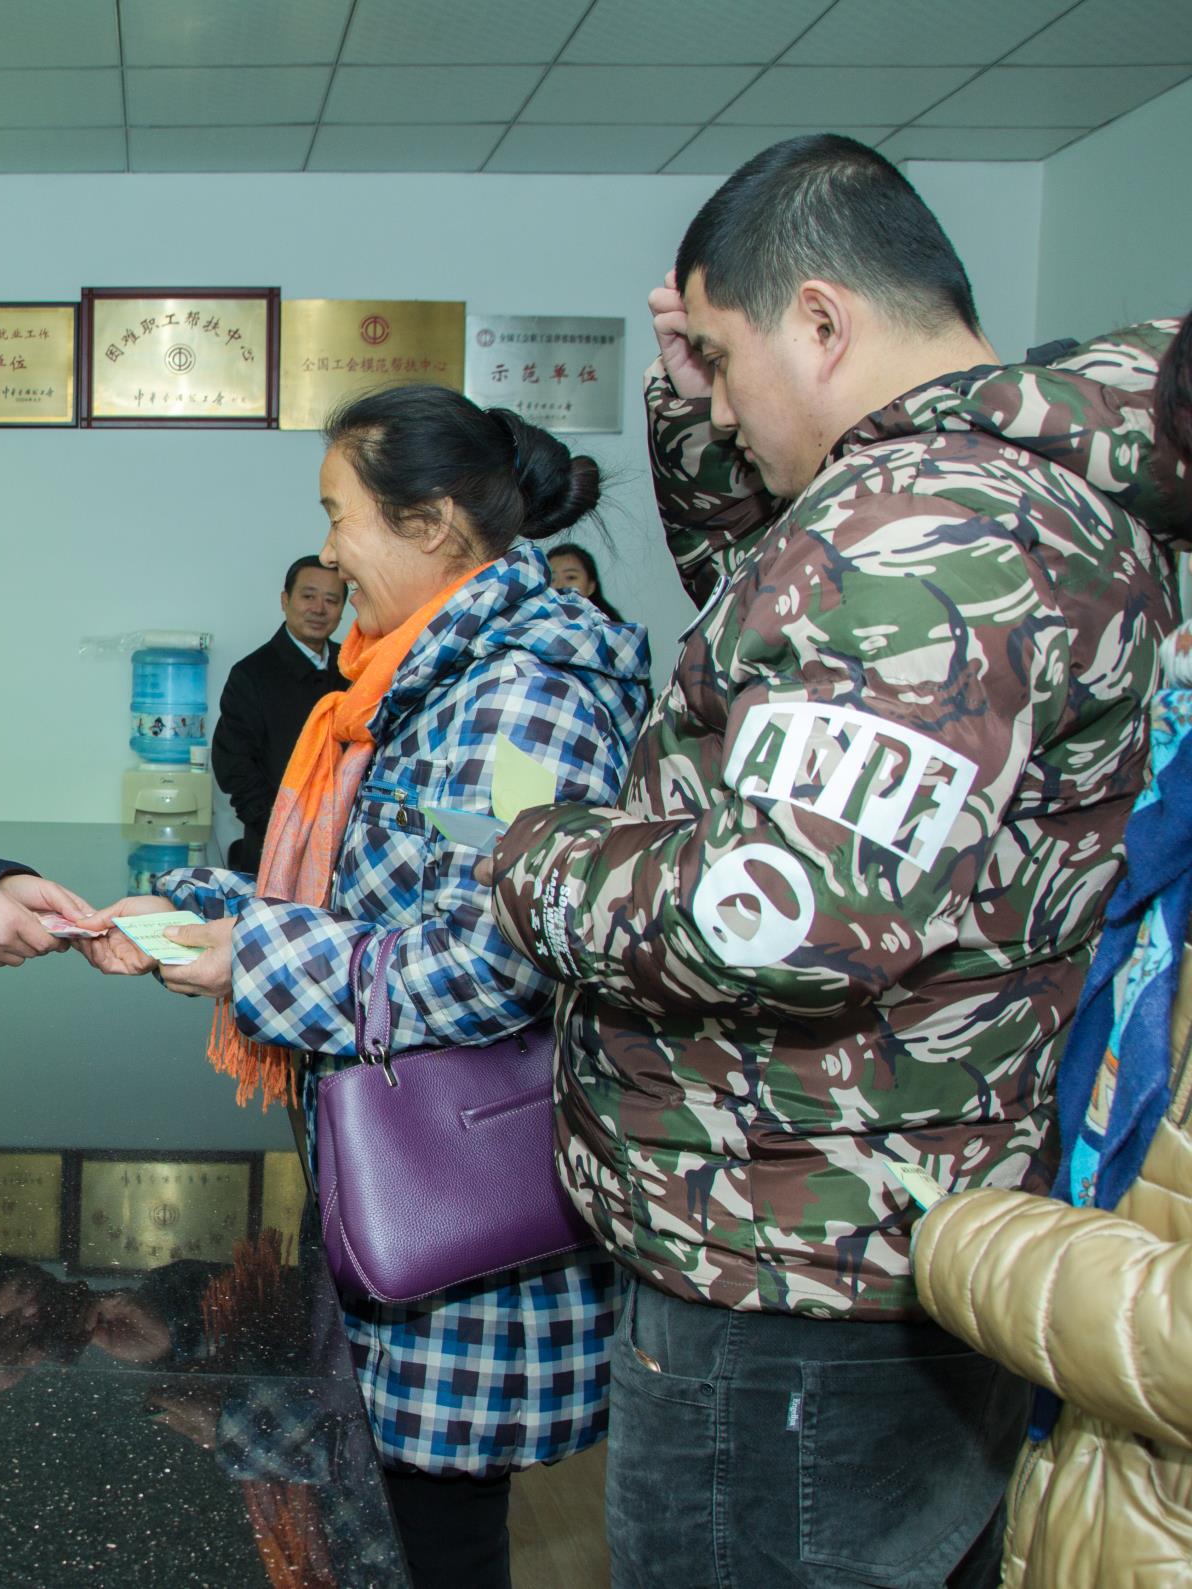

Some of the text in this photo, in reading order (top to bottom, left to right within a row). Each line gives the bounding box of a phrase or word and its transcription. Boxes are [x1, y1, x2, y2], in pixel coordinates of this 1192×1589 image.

[105, 310, 255, 363] 困难职工帮扶中心
[491, 362, 599, 385] 示范单位
